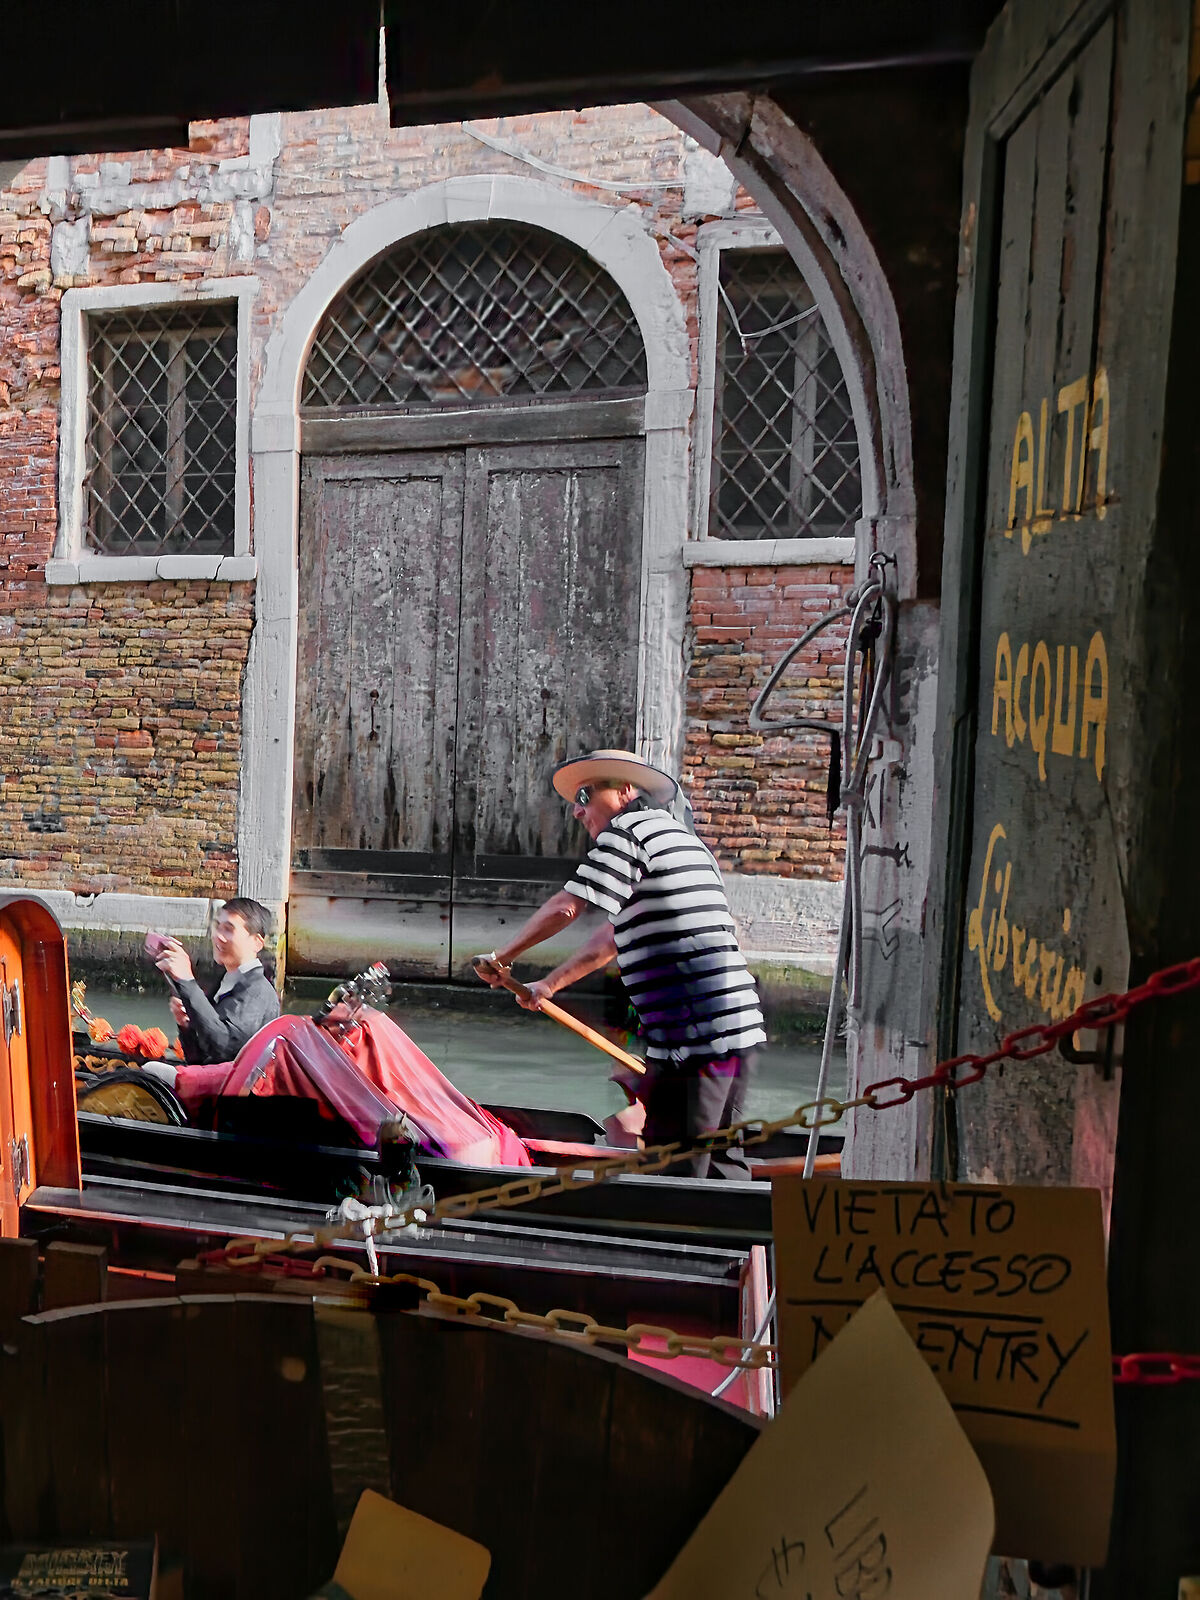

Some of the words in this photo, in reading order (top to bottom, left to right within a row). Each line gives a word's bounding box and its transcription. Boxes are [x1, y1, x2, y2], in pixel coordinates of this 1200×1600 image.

[1004, 366, 1110, 557] ALTA
[991, 630, 1109, 782] ACQUA
[802, 1185, 1016, 1237] VIETATO
[813, 1243, 1072, 1297] L'ACCESSO
[916, 1322, 1090, 1409] ENTRY
